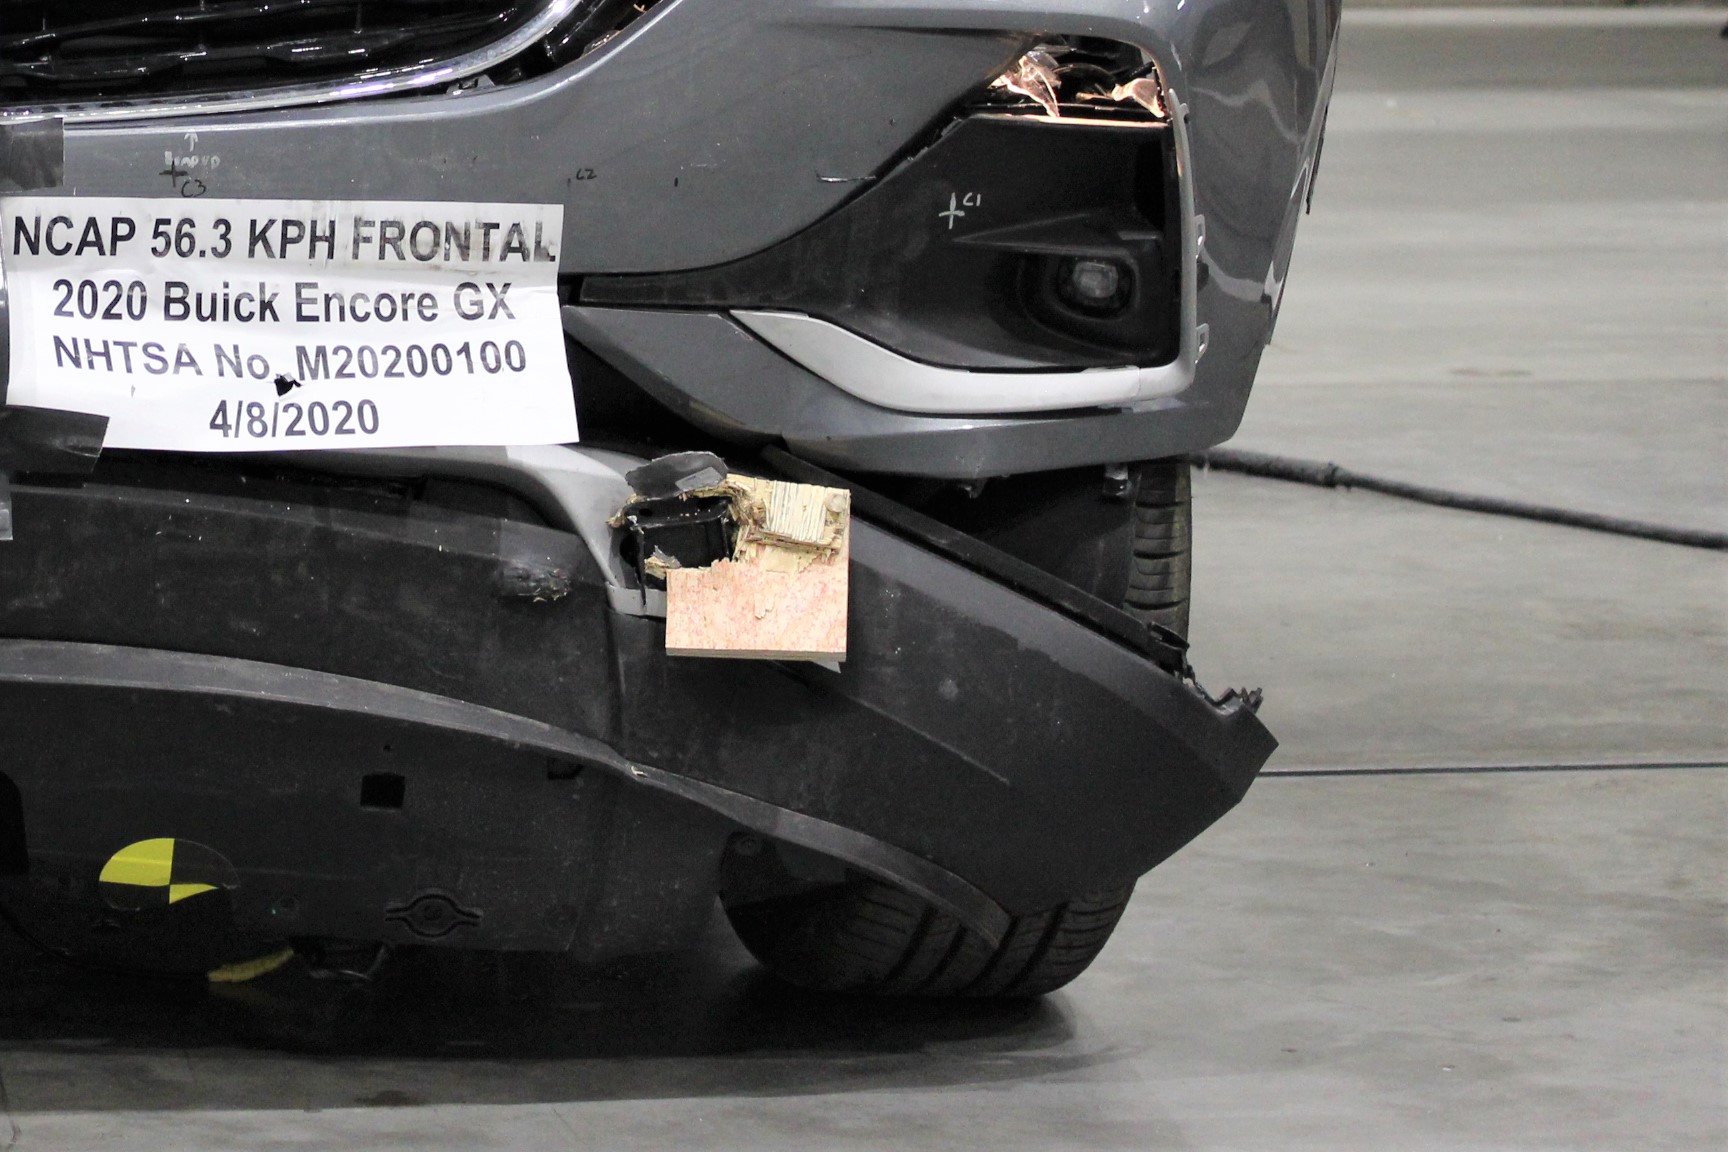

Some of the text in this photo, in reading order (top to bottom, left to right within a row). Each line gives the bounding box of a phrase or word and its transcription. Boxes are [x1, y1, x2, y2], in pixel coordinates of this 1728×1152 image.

[13, 215, 557, 263] NCAP 56.3 KPH FRONTAL
[52, 278, 516, 323] 2020 Buick Encore GX
[52, 335, 527, 381] NHTSA No M20200100
[210, 398, 380, 439] 4/8/2020
